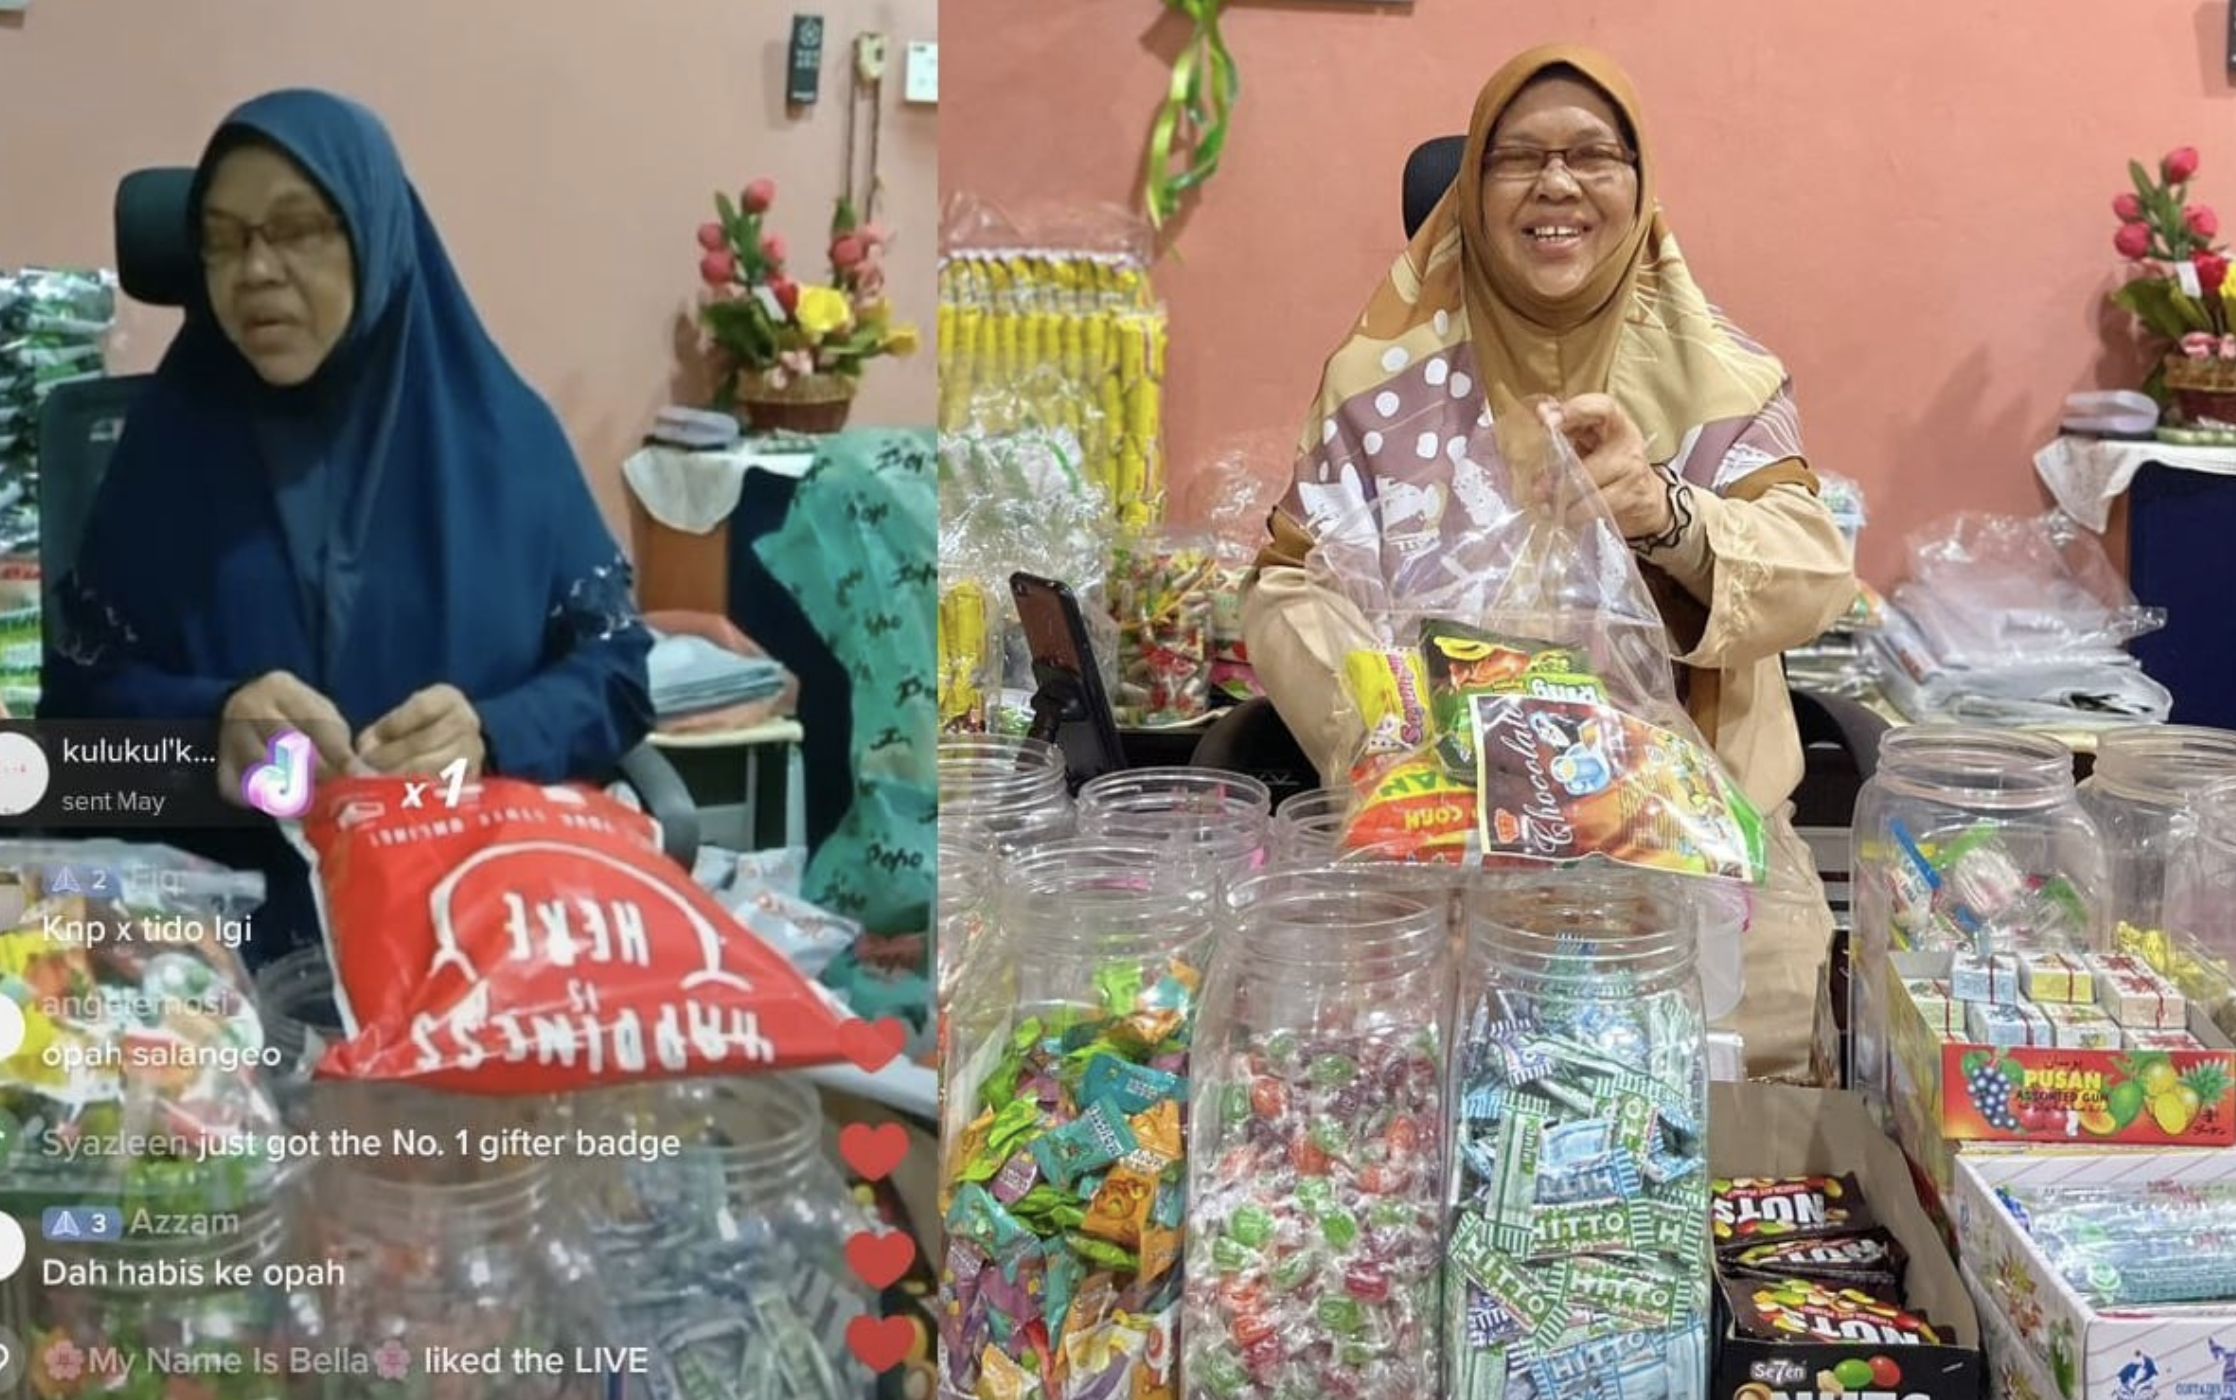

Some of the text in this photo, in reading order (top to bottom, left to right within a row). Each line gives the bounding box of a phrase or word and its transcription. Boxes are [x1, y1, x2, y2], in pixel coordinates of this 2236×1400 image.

[503, 891, 650, 969] HERE
[410, 1000, 776, 1073] HAPPINESS
[2023, 1070, 2102, 1090] PUSAN
[1532, 1211, 1624, 1241] HITTO
[1712, 1192, 1825, 1224] NUTS
[1467, 1235, 1545, 1314] HITTO
